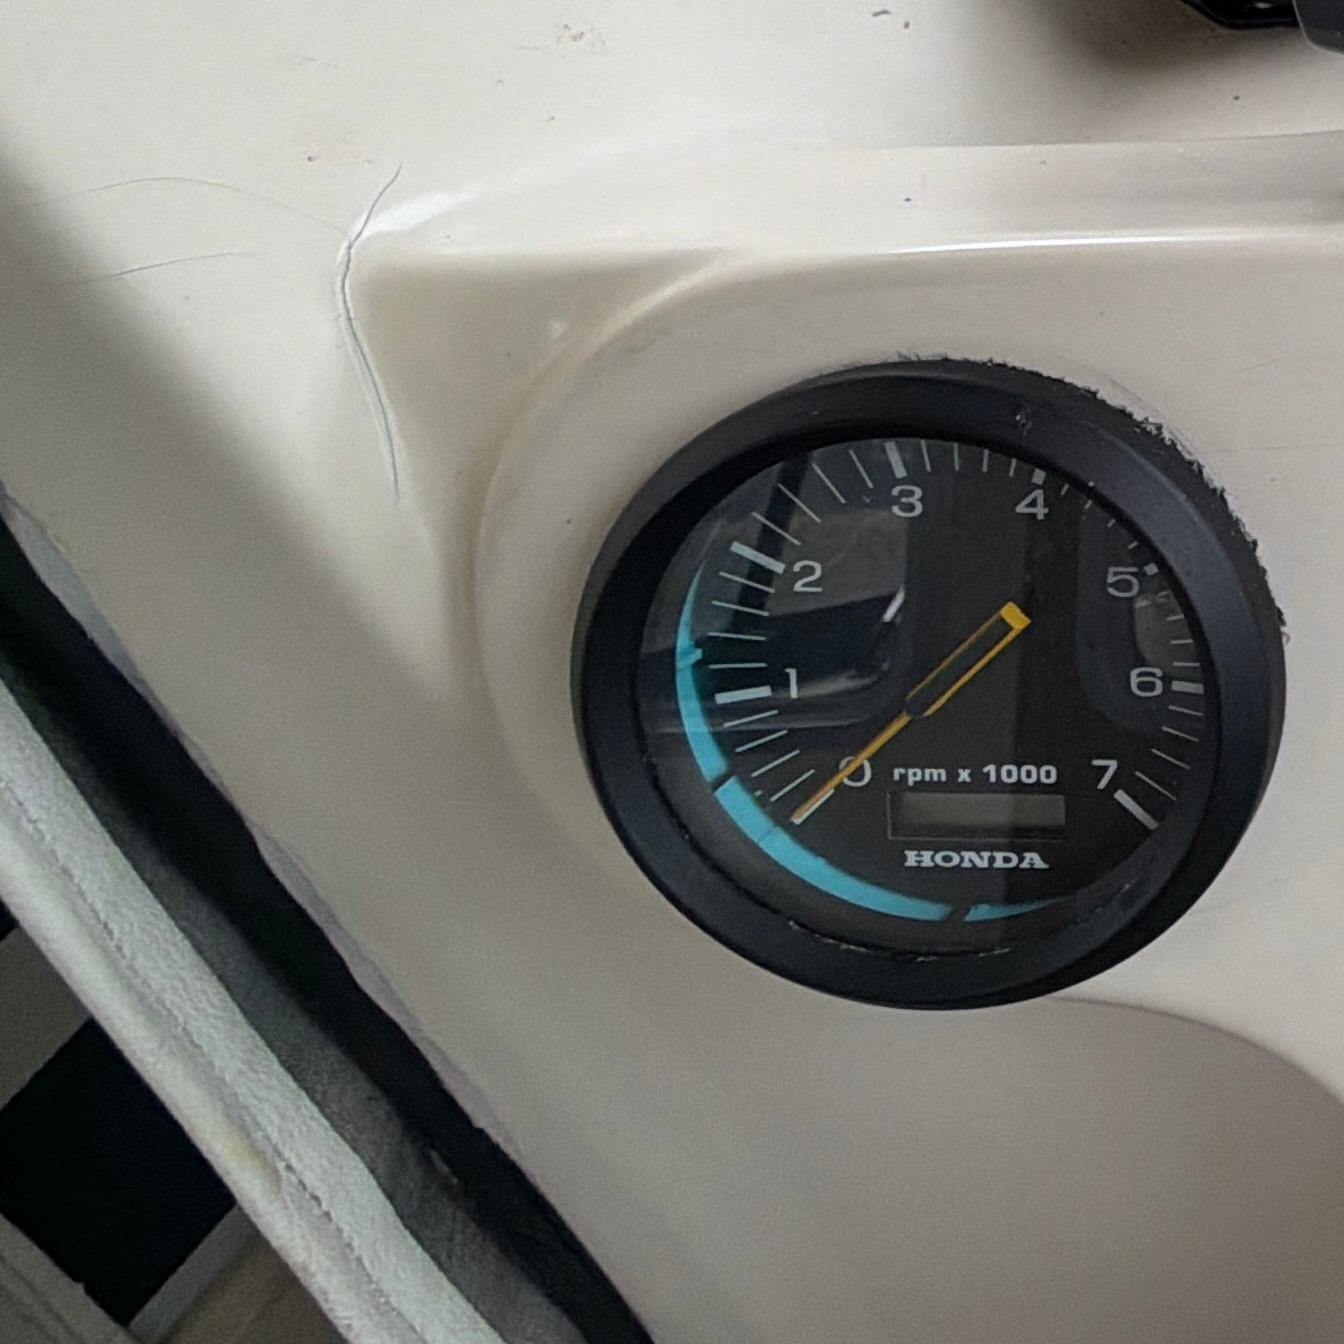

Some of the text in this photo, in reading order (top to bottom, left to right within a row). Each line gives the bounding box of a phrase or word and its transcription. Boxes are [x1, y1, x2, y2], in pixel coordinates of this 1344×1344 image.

[891, 485, 923, 518] 3
[1015, 488, 1049, 520] 4
[792, 561, 824, 592] 2
[1107, 567, 1140, 597] 5
[784, 667, 799, 699] 1
[1129, 667, 1164, 698] 6
[893, 763, 1058, 788] rpm x 1000
[1091, 759, 1119, 788] 7
[903, 850, 1049, 870] HONDA
